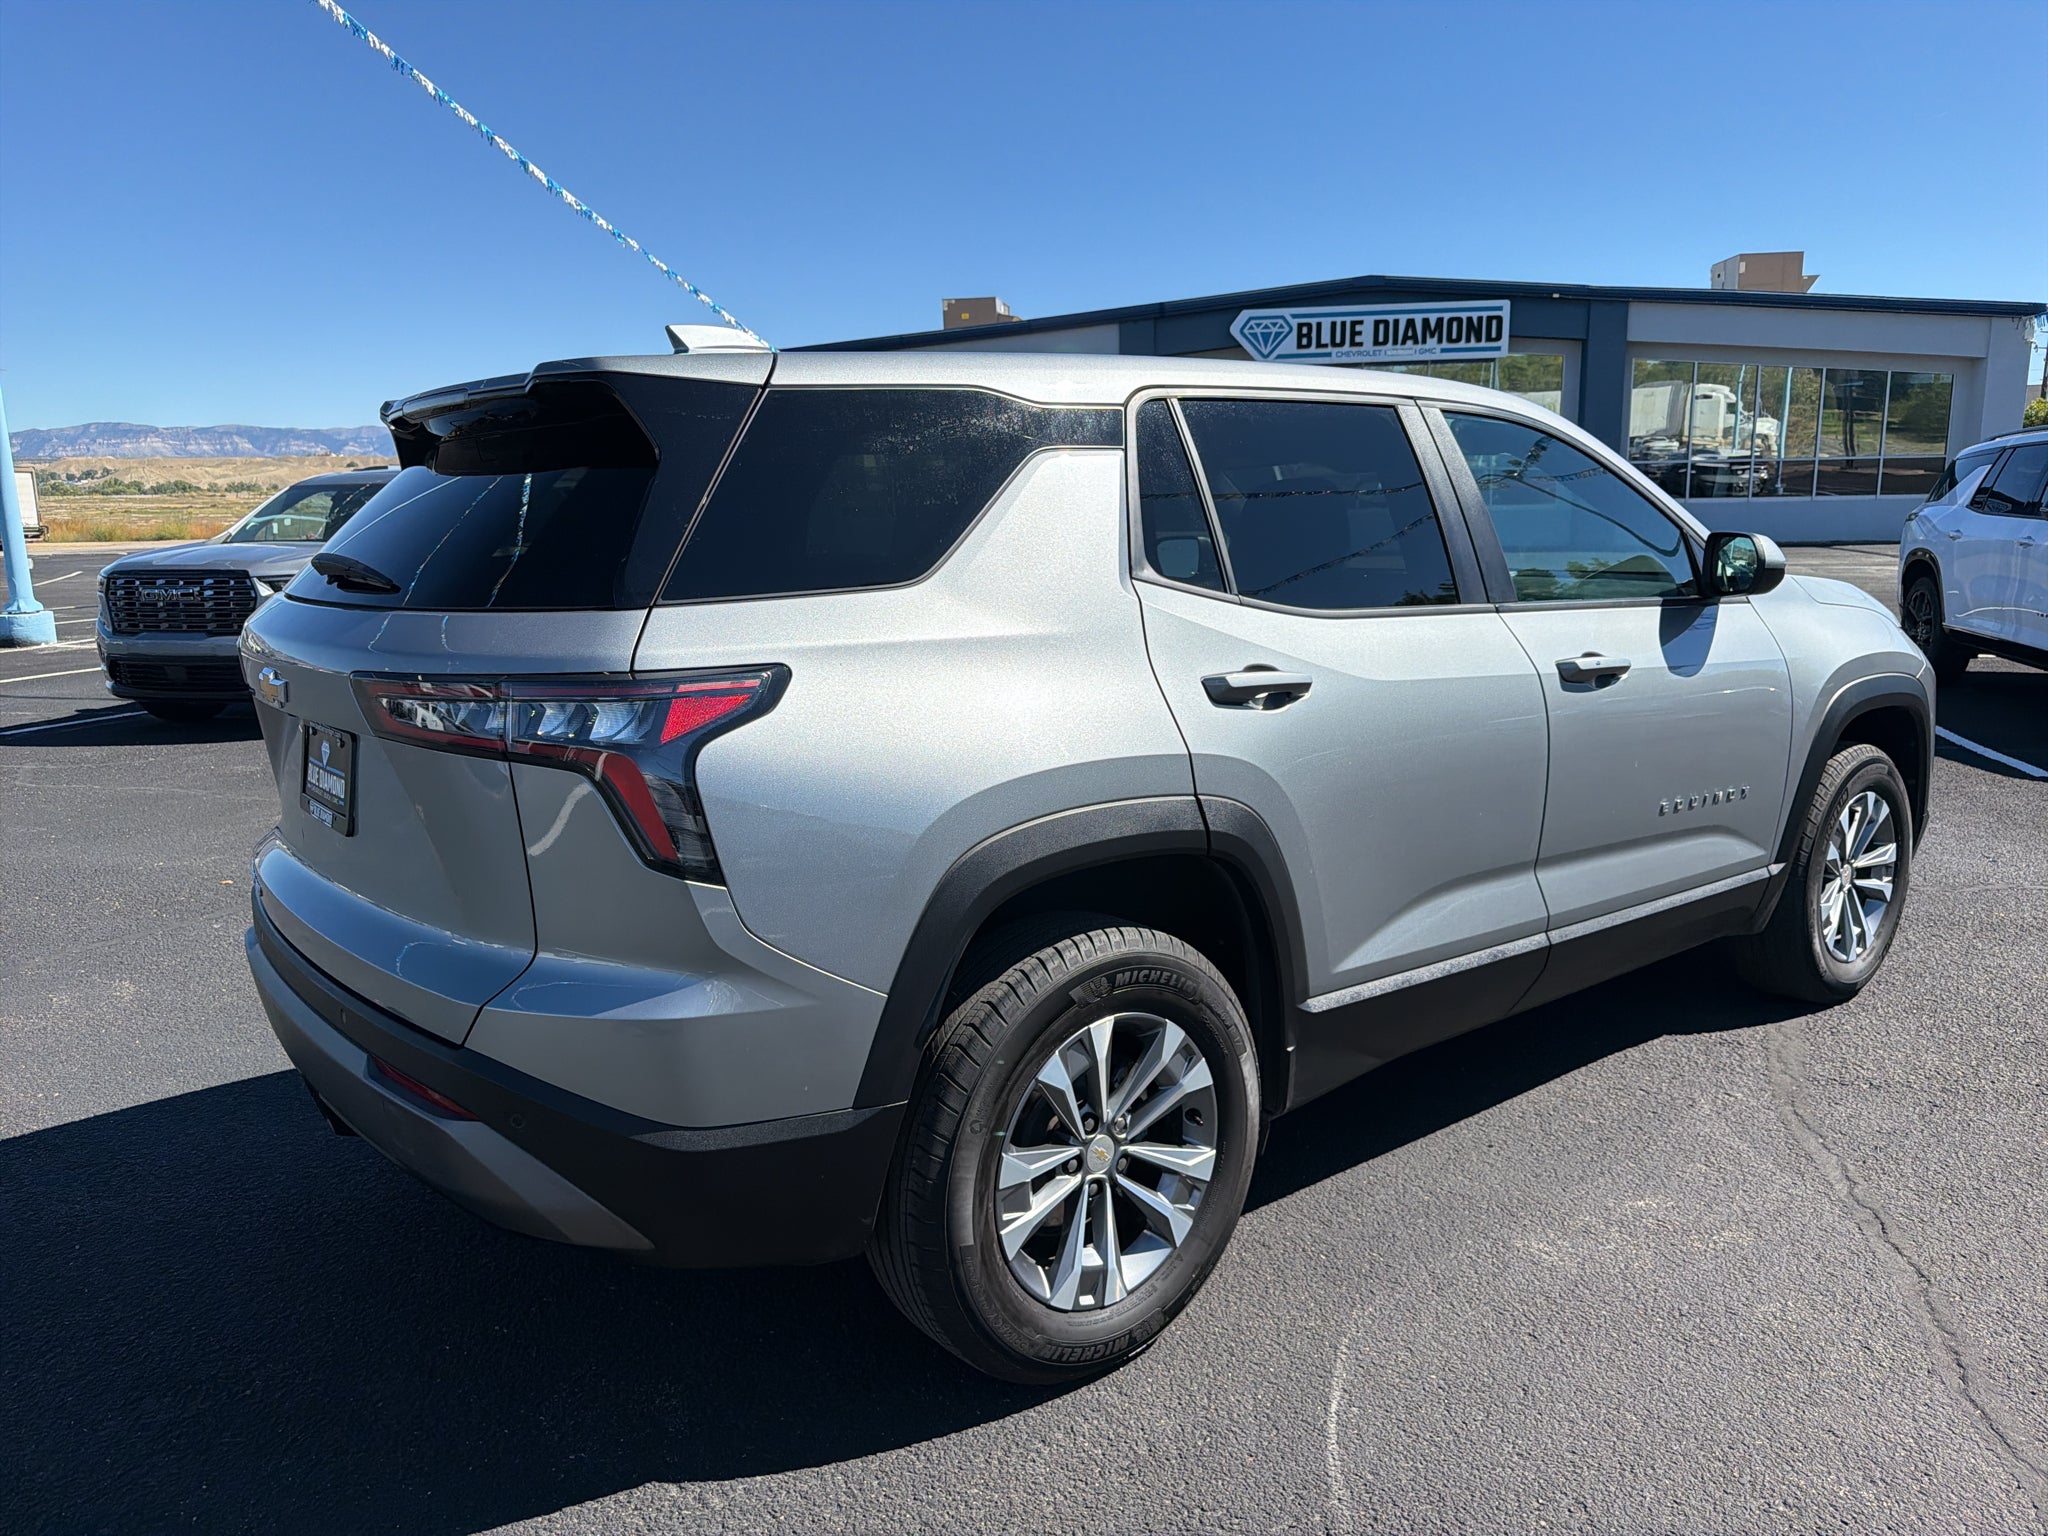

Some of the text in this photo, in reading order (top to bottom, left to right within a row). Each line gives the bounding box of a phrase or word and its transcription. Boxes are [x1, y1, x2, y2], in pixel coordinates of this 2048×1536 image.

[1296, 314, 1503, 350] BLUE DIAMOND
[1335, 347, 1437, 358] CHEVROLET GMC
[141, 588, 195, 601] GMC
[1658, 785, 1751, 817] EQUINOX
[1114, 969, 1198, 997] MICHELIN
[1040, 1334, 1130, 1363] MICHELIN
